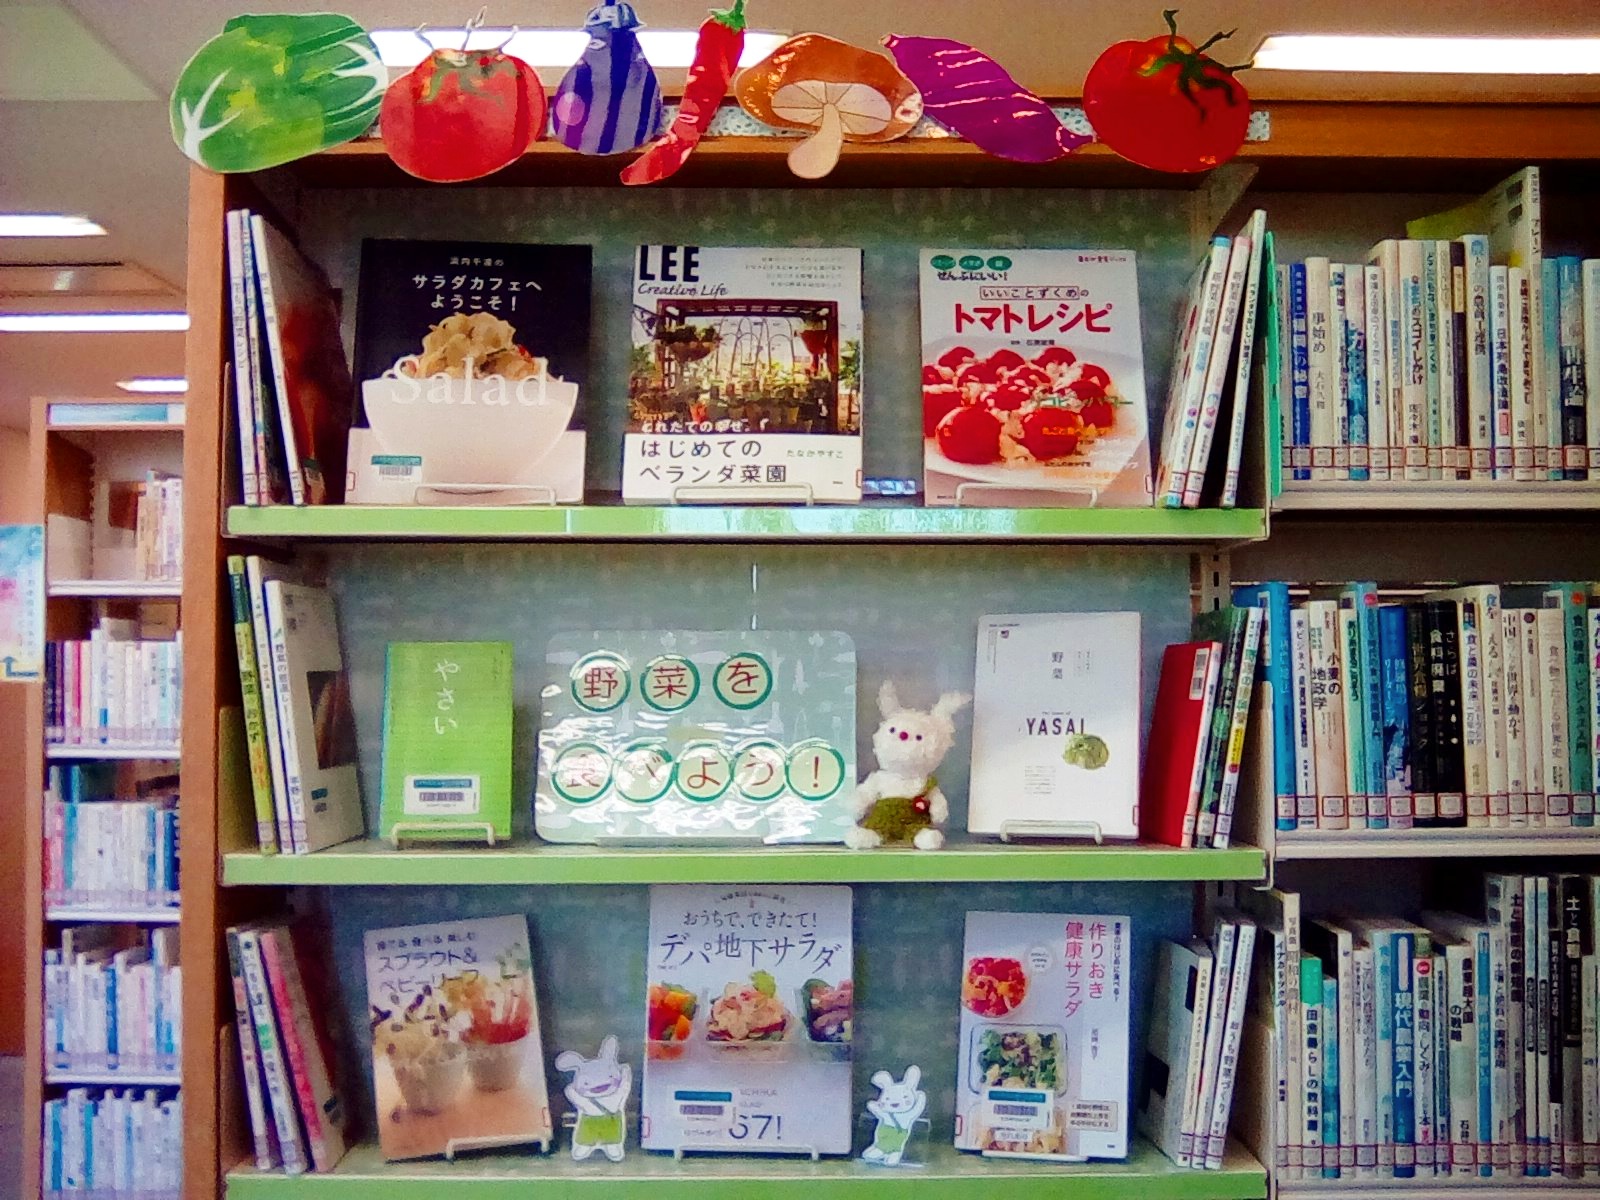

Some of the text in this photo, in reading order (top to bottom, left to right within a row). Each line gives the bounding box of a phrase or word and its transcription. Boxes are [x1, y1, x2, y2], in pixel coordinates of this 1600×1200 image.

[639, 245, 699, 282] LEE
[412, 274, 543, 292] サラダカフェへ
[637, 283, 729, 300] Creative Life
[983, 287, 1089, 298] いいことずくめの
[430, 296, 517, 312] ようこそ！
[955, 302, 1113, 334] トマトレシピ
[391, 355, 551, 406] Salad
[641, 440, 762, 458] はじめての
[786, 450, 843, 461] たなかやすこ
[640, 464, 787, 485] ベランダ菜園
[1446, 630, 1458, 676] さらば
[583, 661, 759, 699] 野菜を
[434, 659, 460, 735] やさい
[1026, 717, 1085, 736] YASAI
[684, 911, 818, 929] おうちで、できたて！
[660, 932, 843, 974] デパ地下サラダ
[1088, 923, 1107, 1000] 作りおき
[1065, 921, 1083, 1018] 健康サラダ
